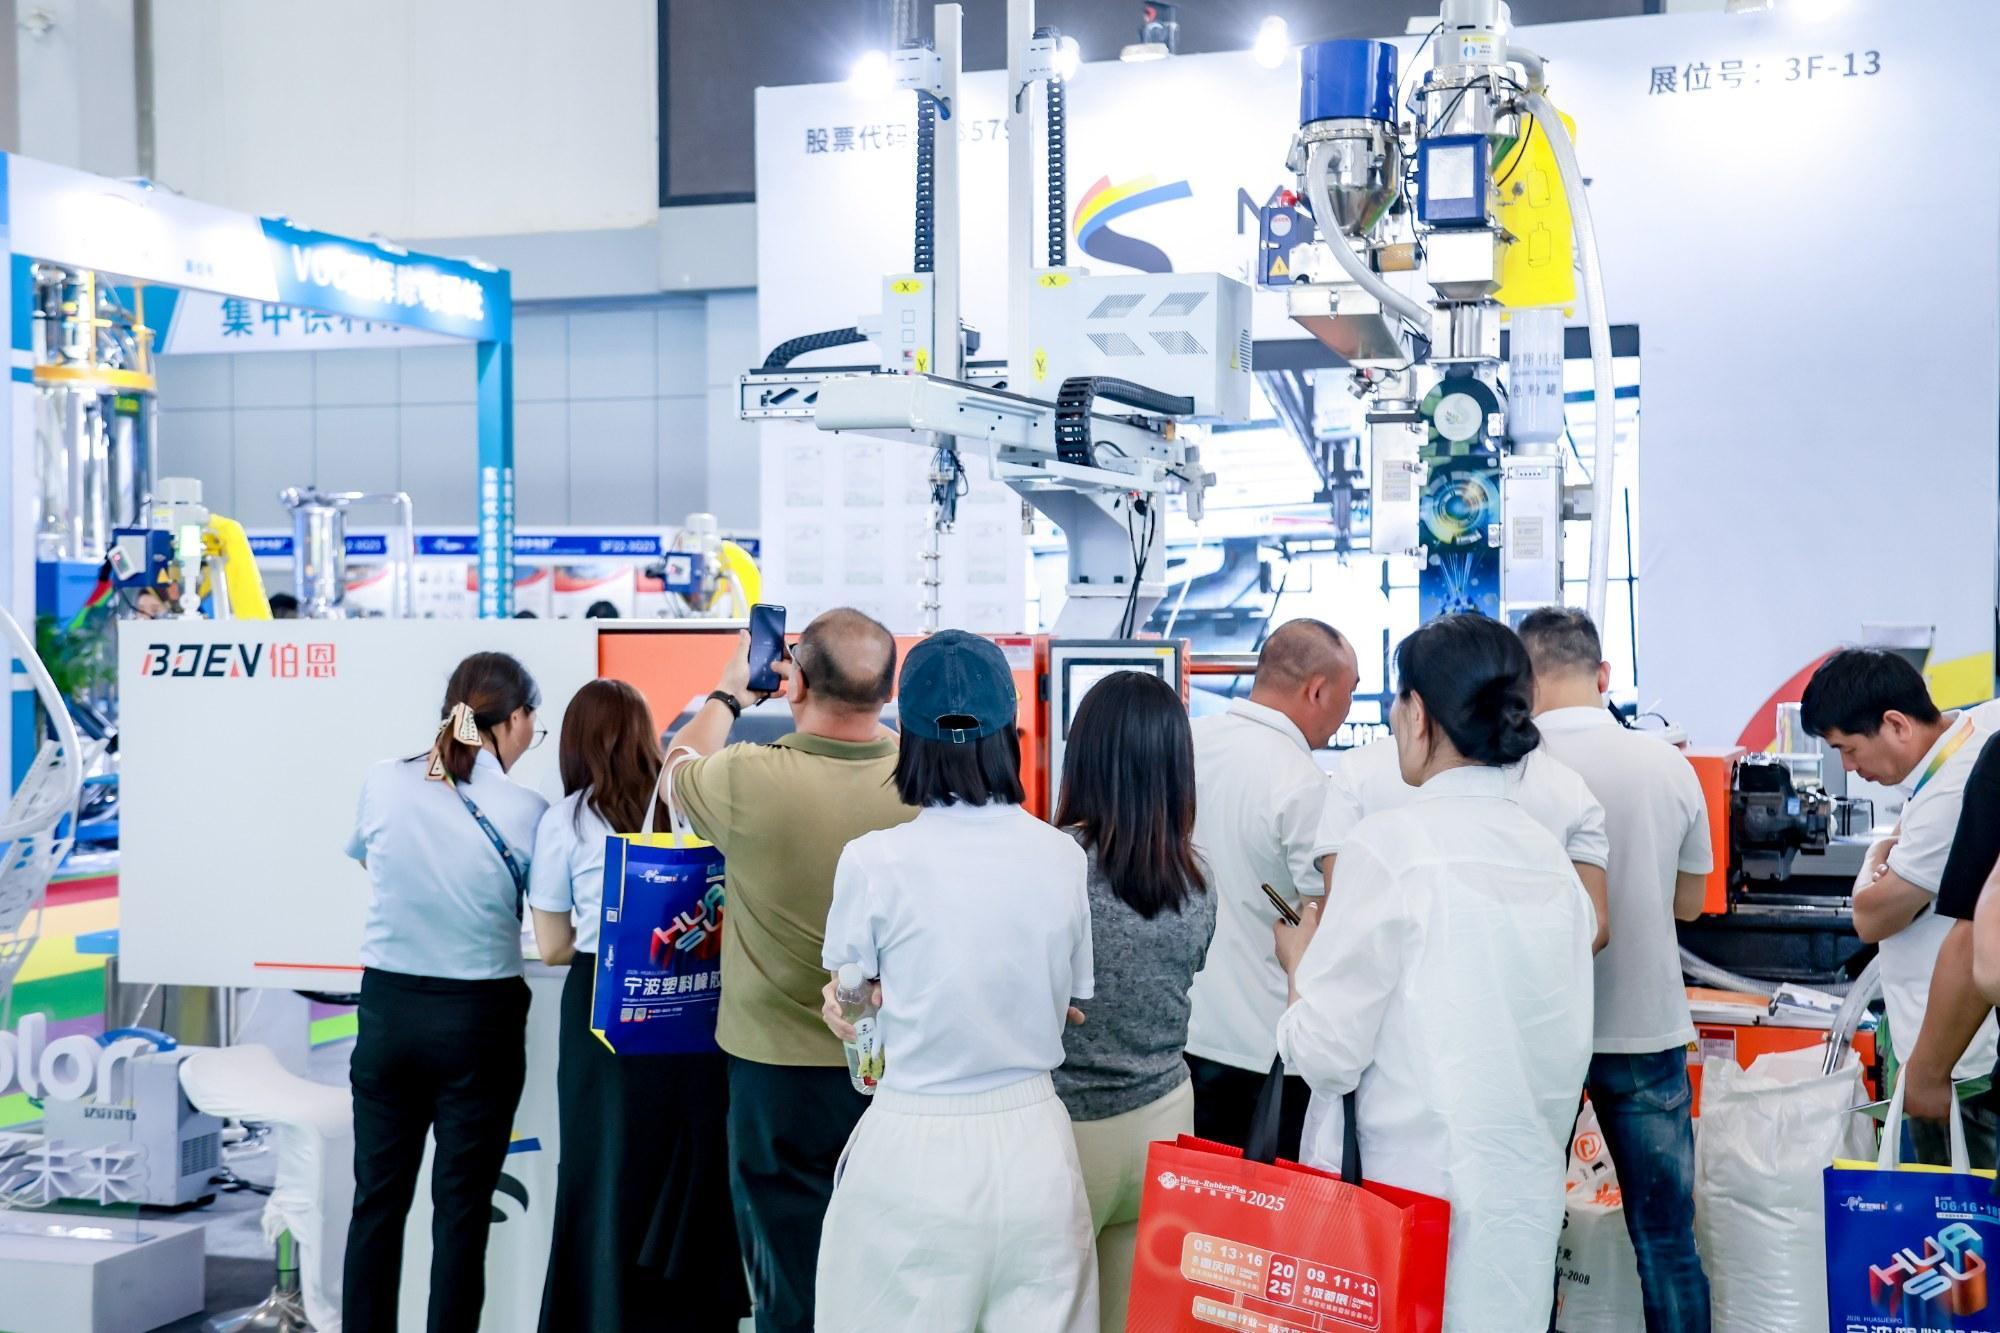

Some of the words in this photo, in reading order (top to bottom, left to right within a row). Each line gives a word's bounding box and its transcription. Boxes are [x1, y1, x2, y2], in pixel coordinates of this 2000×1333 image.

[1785, 50, 1881, 82] 3F-13
[141, 643, 263, 678] BOEN
[270, 643, 336, 678] 伯恩
[1247, 1190, 1286, 1212] 2025
[1271, 1261, 1295, 1279] 20
[1268, 1279, 1293, 1297] 25
